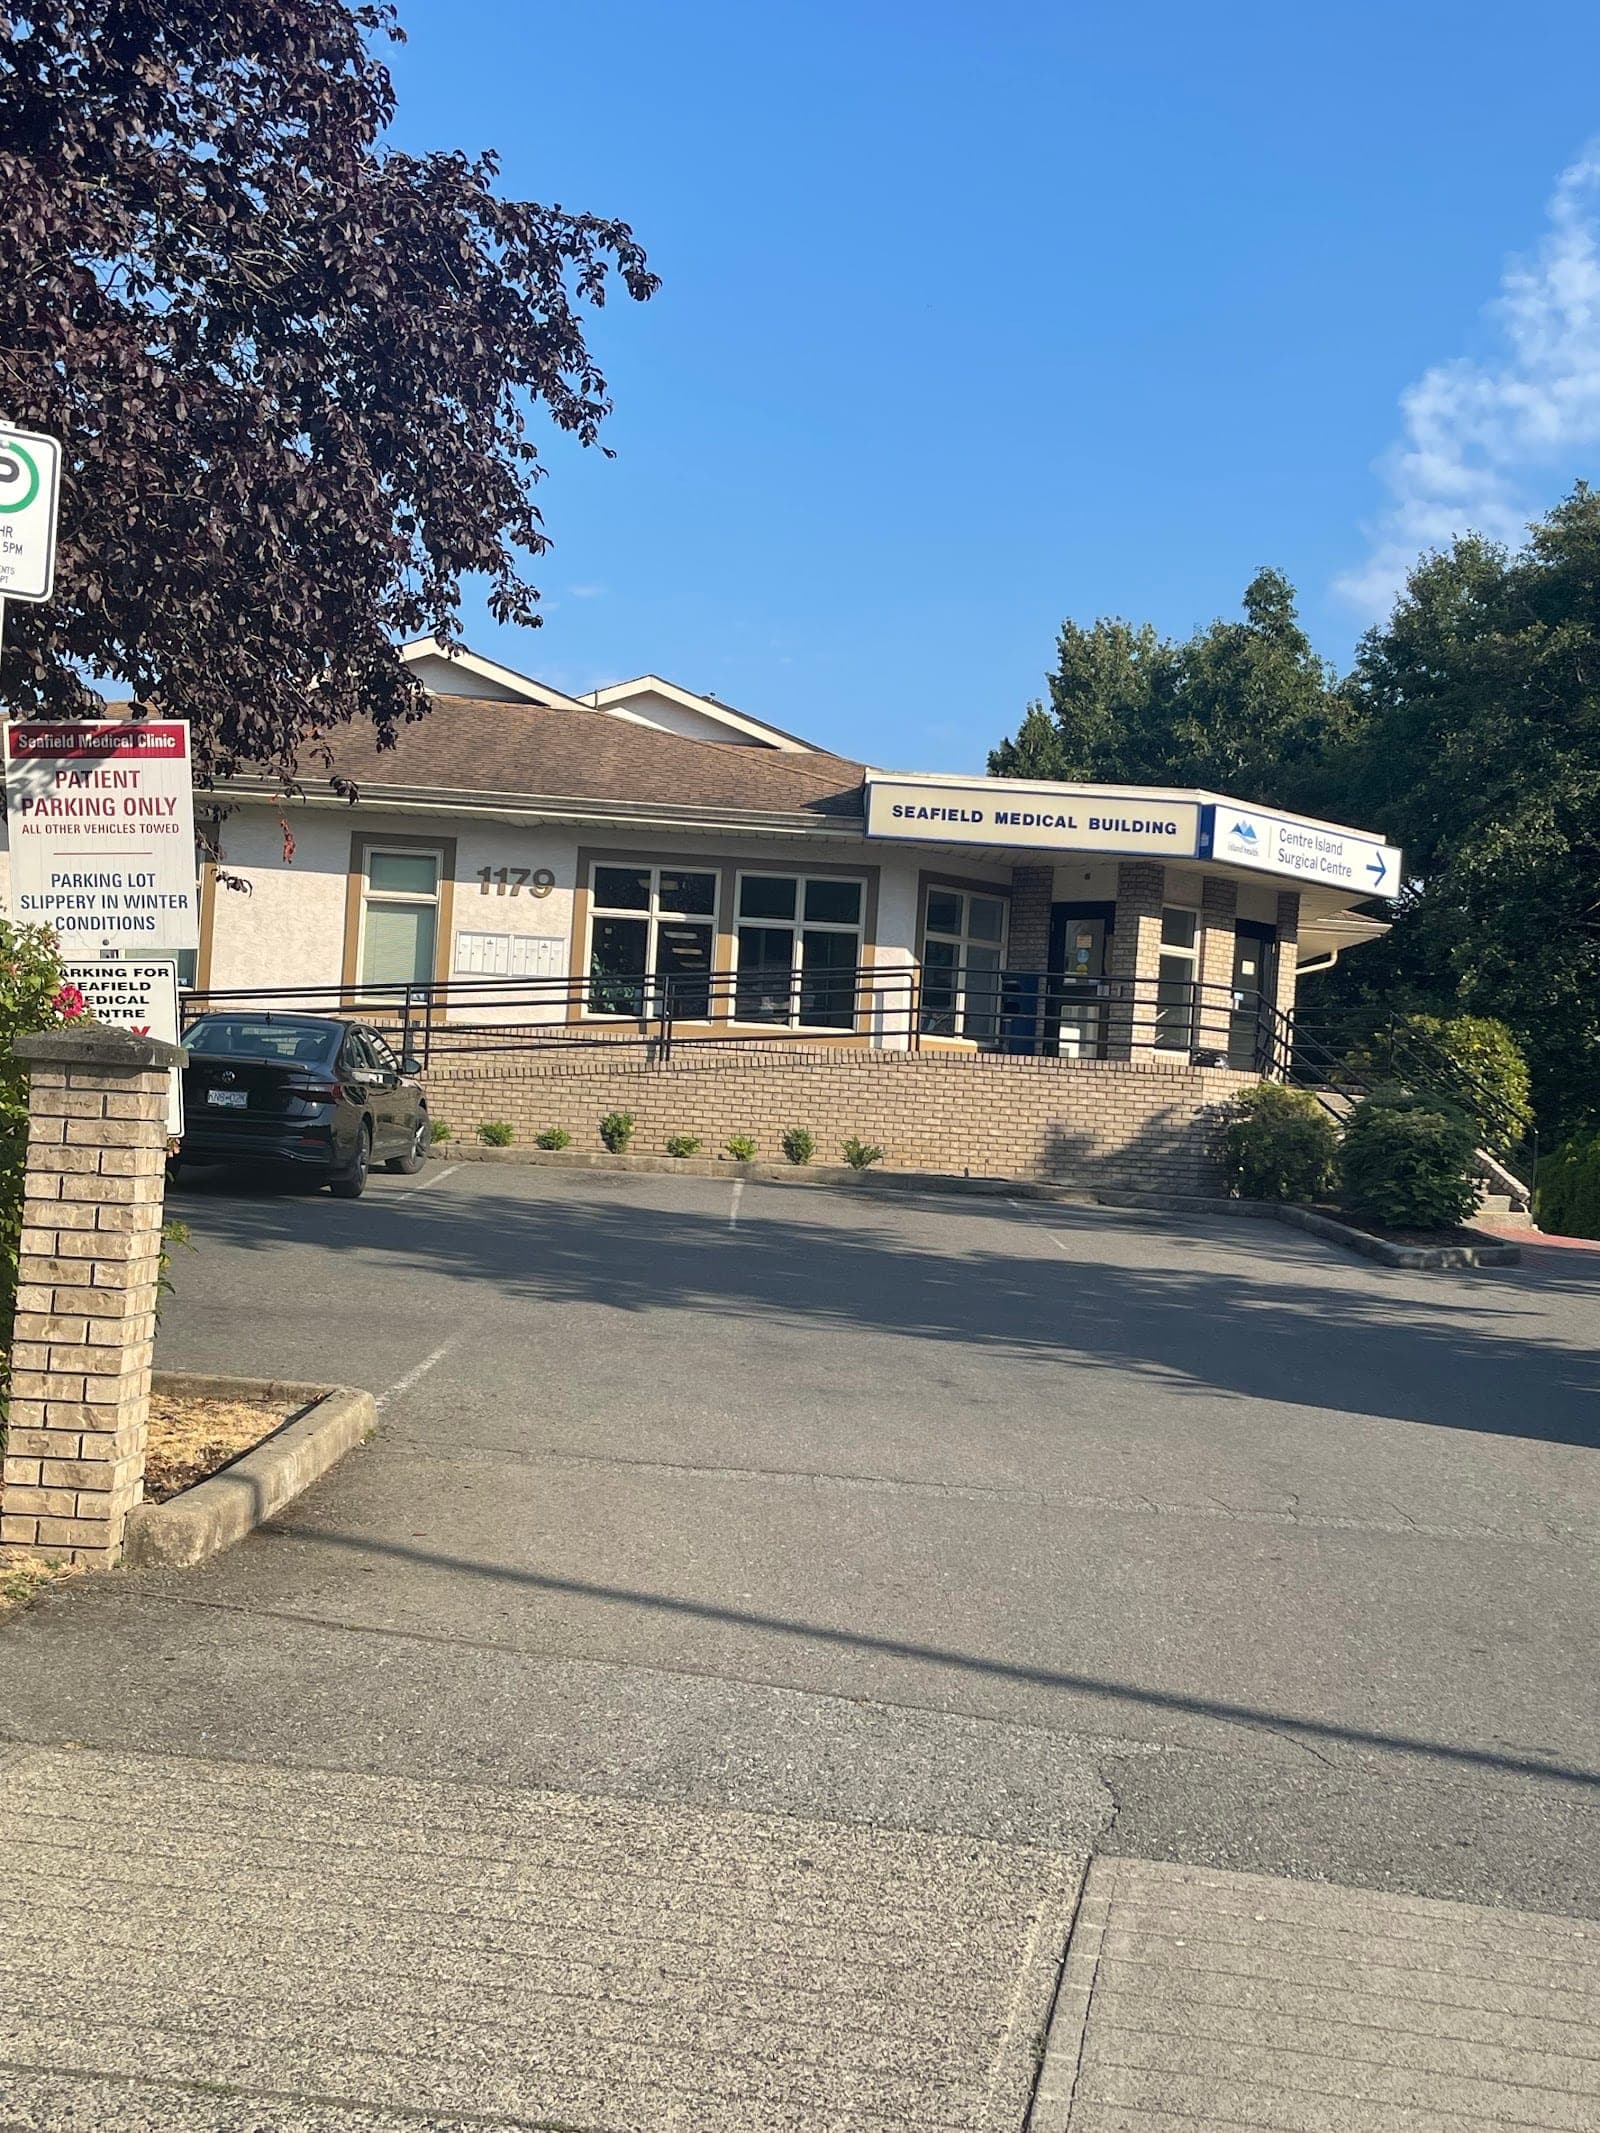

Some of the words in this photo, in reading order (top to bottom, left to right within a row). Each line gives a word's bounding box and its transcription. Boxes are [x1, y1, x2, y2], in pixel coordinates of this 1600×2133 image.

[3, 541, 23, 556] 5PM
[19, 734, 74, 749] Seafield
[78, 733, 133, 749] Medical
[138, 733, 176, 749] Clinic
[55, 770, 141, 789] PATIENT
[22, 797, 116, 817] PARKING
[124, 797, 177, 816] ONLY
[892, 804, 984, 823] SEAFIELD
[994, 811, 1077, 829] MEDICAL
[1088, 817, 1177, 835] BUILDING
[22, 824, 42, 834] ALL
[45, 823, 81, 834] OTHER
[84, 823, 136, 834] VEHICLES
[140, 823, 179, 834] TOWED
[1279, 828, 1313, 848] Centre
[1315, 835, 1343, 856] Island
[1278, 848, 1318, 869] Surgical
[1320, 857, 1352, 877] Centre
[51, 873, 122, 888] PARKING
[128, 873, 156, 888] LOT
[477, 866, 556, 898] 1179
[20, 895, 96, 909] SLIPPERY
[102, 894, 118, 909] IN
[123, 894, 188, 909] WINTER
[55, 916, 156, 931] CONDITIONS
[60, 968, 127, 977] ARKING
[134, 968, 169, 977] FOR
[71, 982, 151, 991] EAFIELD
[84, 995, 150, 1005] EDICAL
[90, 1009, 145, 1018] ENTRE
